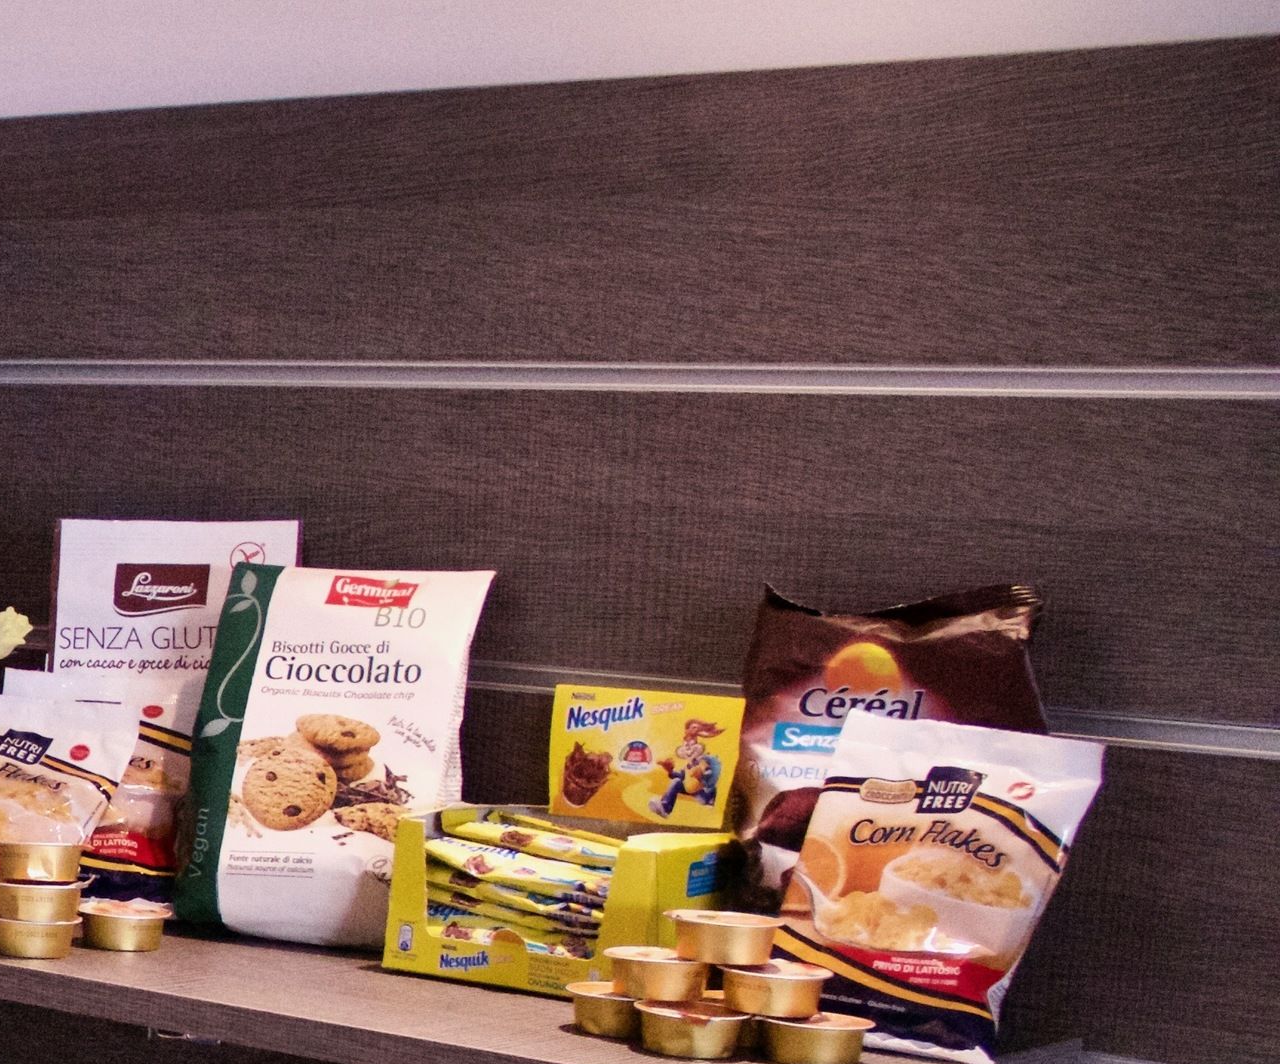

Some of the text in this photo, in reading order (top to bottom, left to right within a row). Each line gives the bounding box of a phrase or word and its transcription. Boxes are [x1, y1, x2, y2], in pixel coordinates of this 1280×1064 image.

[335, 577, 415, 597] Germinal
[374, 606, 426, 629] BIO
[59, 626, 143, 650] SENZA
[271, 640, 390, 654] Biscotti Gocce di
[59, 658, 85, 670] con
[86, 658, 126, 670] cacao
[127, 658, 137, 670] e
[138, 658, 172, 674] gocce
[174, 655, 190, 670] di
[265, 655, 423, 684] Cioccolato
[260, 685, 300, 696] Organic
[302, 687, 341, 698] Biscuits
[344, 690, 392, 700] Chocolate
[566, 696, 645, 732] Nesquik
[3, 737, 42, 755] NUTRI
[781, 727, 840, 748] Senz
[927, 780, 972, 794] NUTRI
[922, 795, 967, 809] FREE
[188, 808, 209, 878] Vegan
[850, 818, 1008, 868] Corn Flakes
[439, 950, 489, 971] Nesquik
[872, 960, 901, 973] PRIVO
